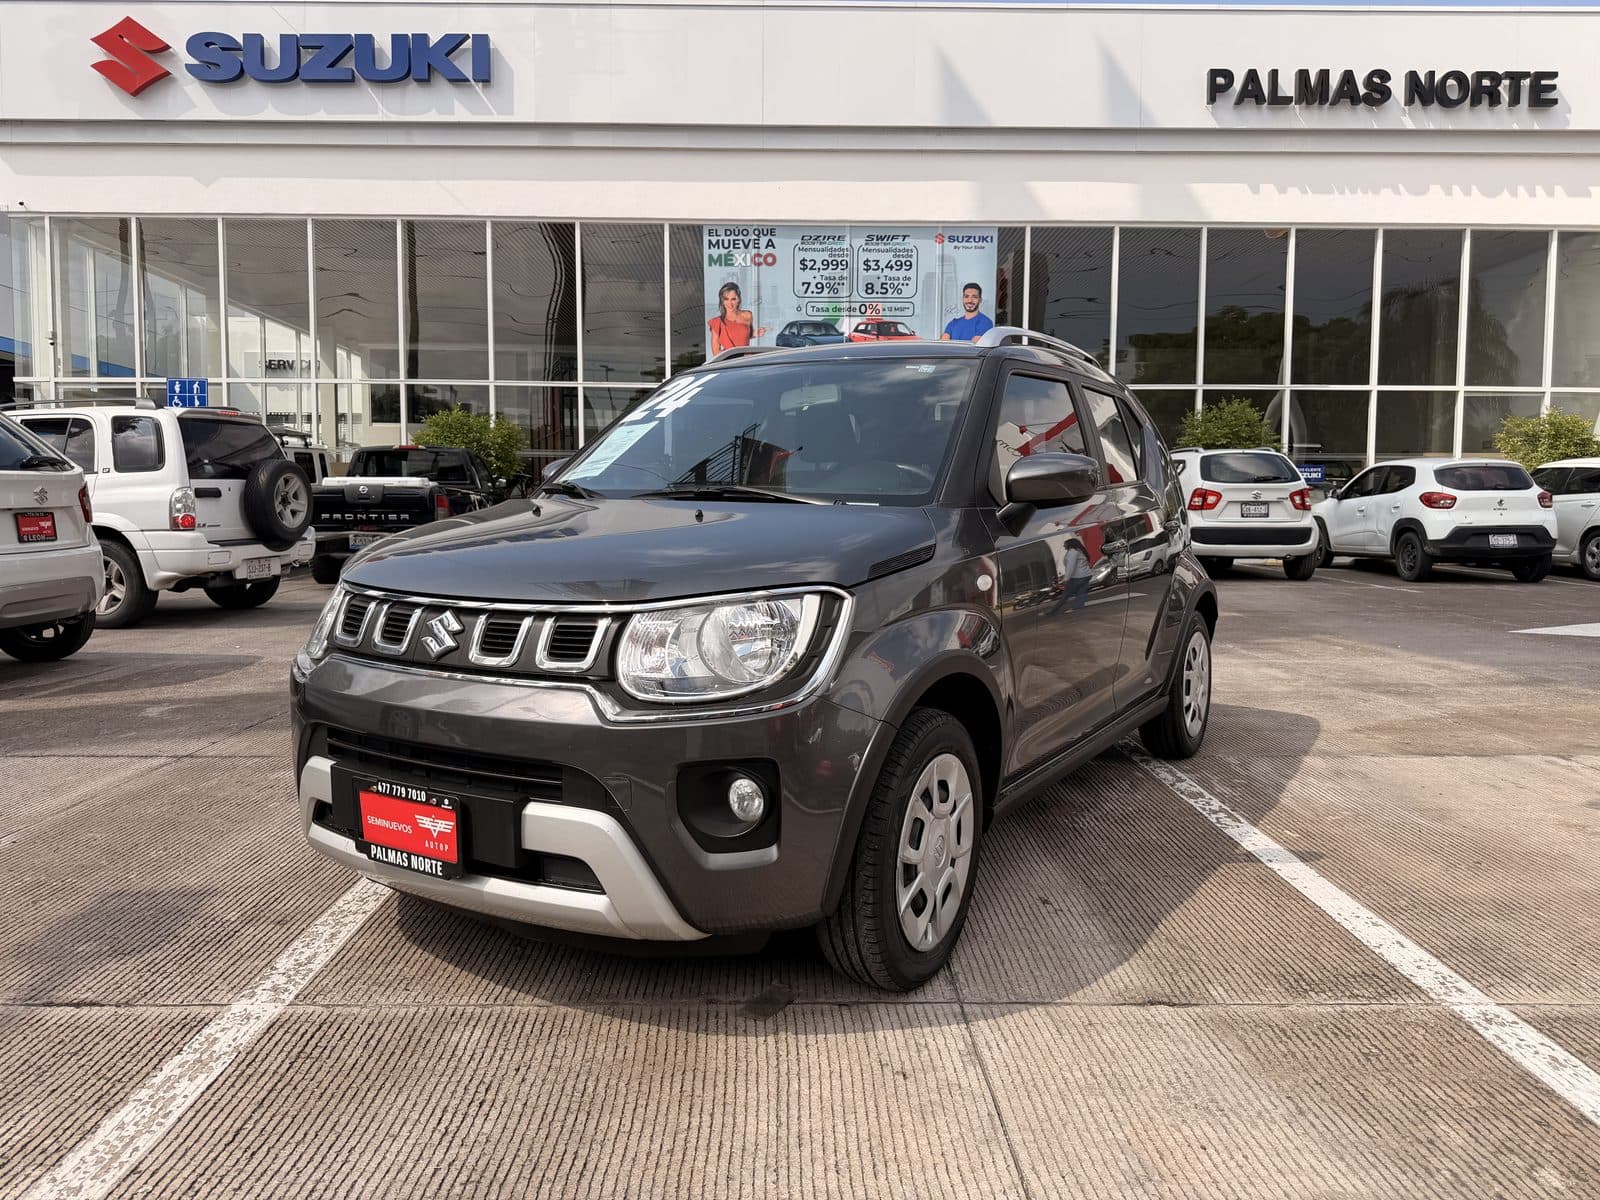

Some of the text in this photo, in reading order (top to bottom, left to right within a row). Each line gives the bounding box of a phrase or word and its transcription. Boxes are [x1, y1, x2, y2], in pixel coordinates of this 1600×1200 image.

[185, 31, 492, 84] SUZUKI
[1207, 68, 1559, 108] PALMAS NORTE
[708, 226, 777, 238] EL DÚO QUE
[865, 234, 910, 242] SWIFT
[947, 234, 994, 244] SUZUKI
[708, 238, 776, 250] MUEVE A
[708, 250, 777, 267] MÉXICO
[800, 257, 849, 273] $2,999
[863, 257, 913, 273] $3,499
[831, 305, 857, 313] desde
[858, 303, 881, 315] 0%
[377, 781, 426, 802] 477 779 7010
[367, 815, 413, 834] SEMINUEVOS
[424, 840, 449, 852] AUTOP
[371, 844, 443, 876] PALMAS NORTE
